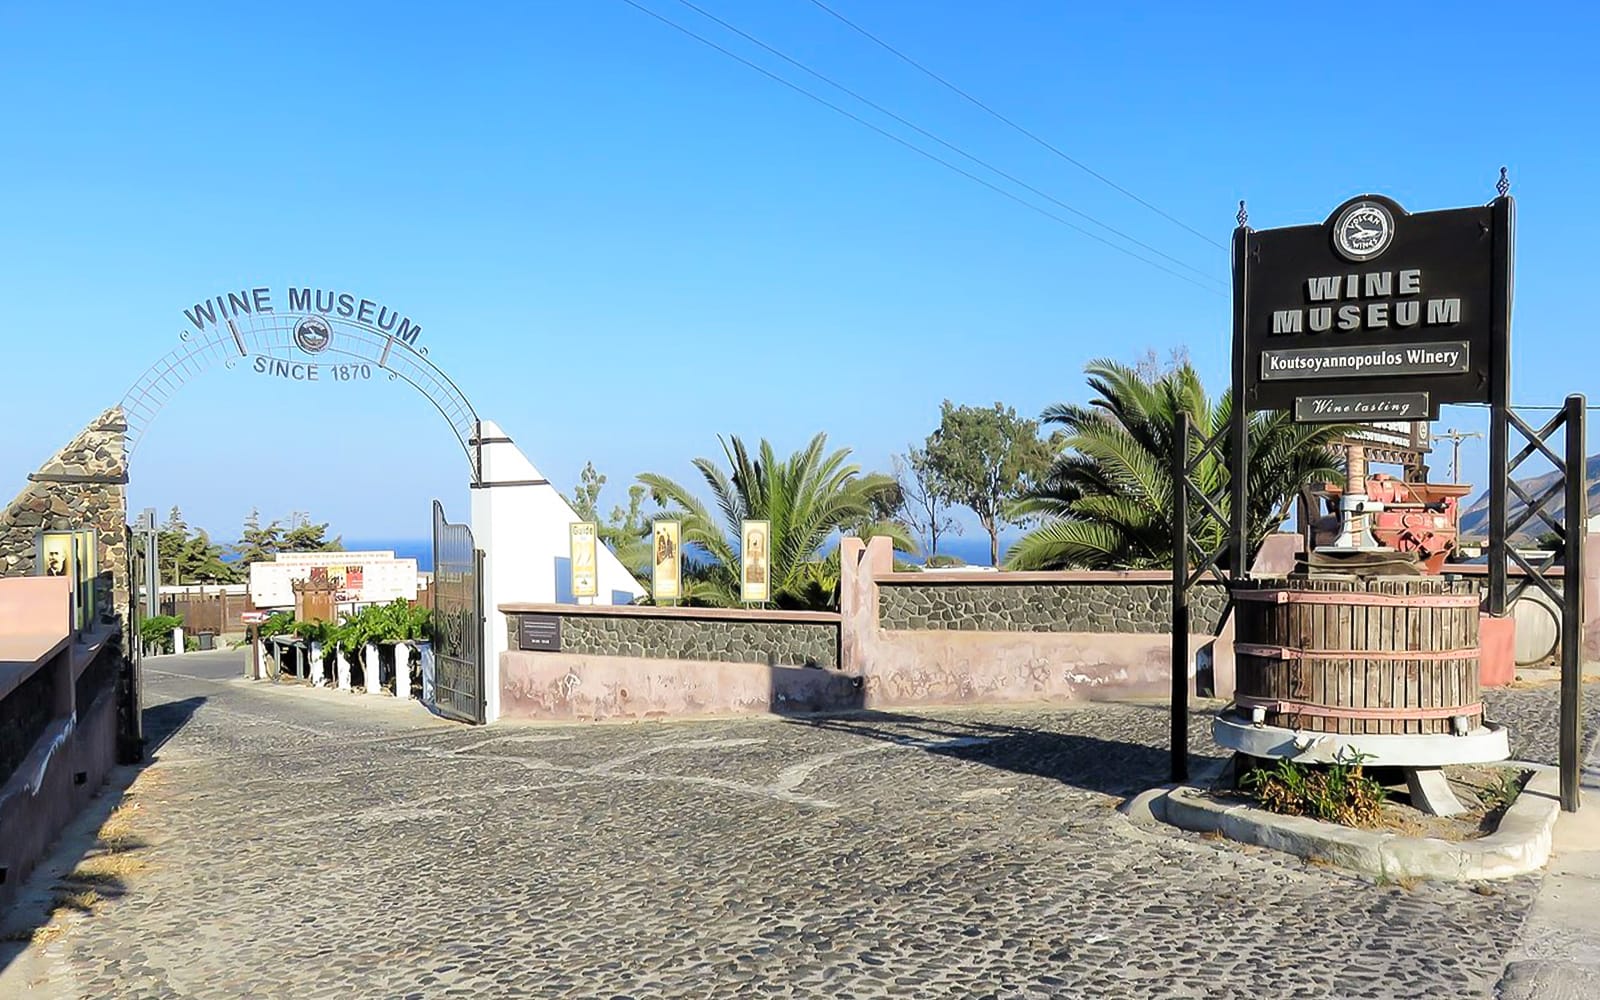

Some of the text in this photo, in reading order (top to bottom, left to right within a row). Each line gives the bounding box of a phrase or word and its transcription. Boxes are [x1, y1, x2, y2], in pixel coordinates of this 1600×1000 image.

[1307, 269, 1421, 301] WINE
[183, 287, 422, 346] WINE MUSEUM
[1272, 298, 1461, 334] MUSEUM
[253, 356, 371, 381] SINCE 1870
[1270, 351, 1403, 372] Koutsoyannopoulos
[1312, 399, 1410, 416] Wine tasting
